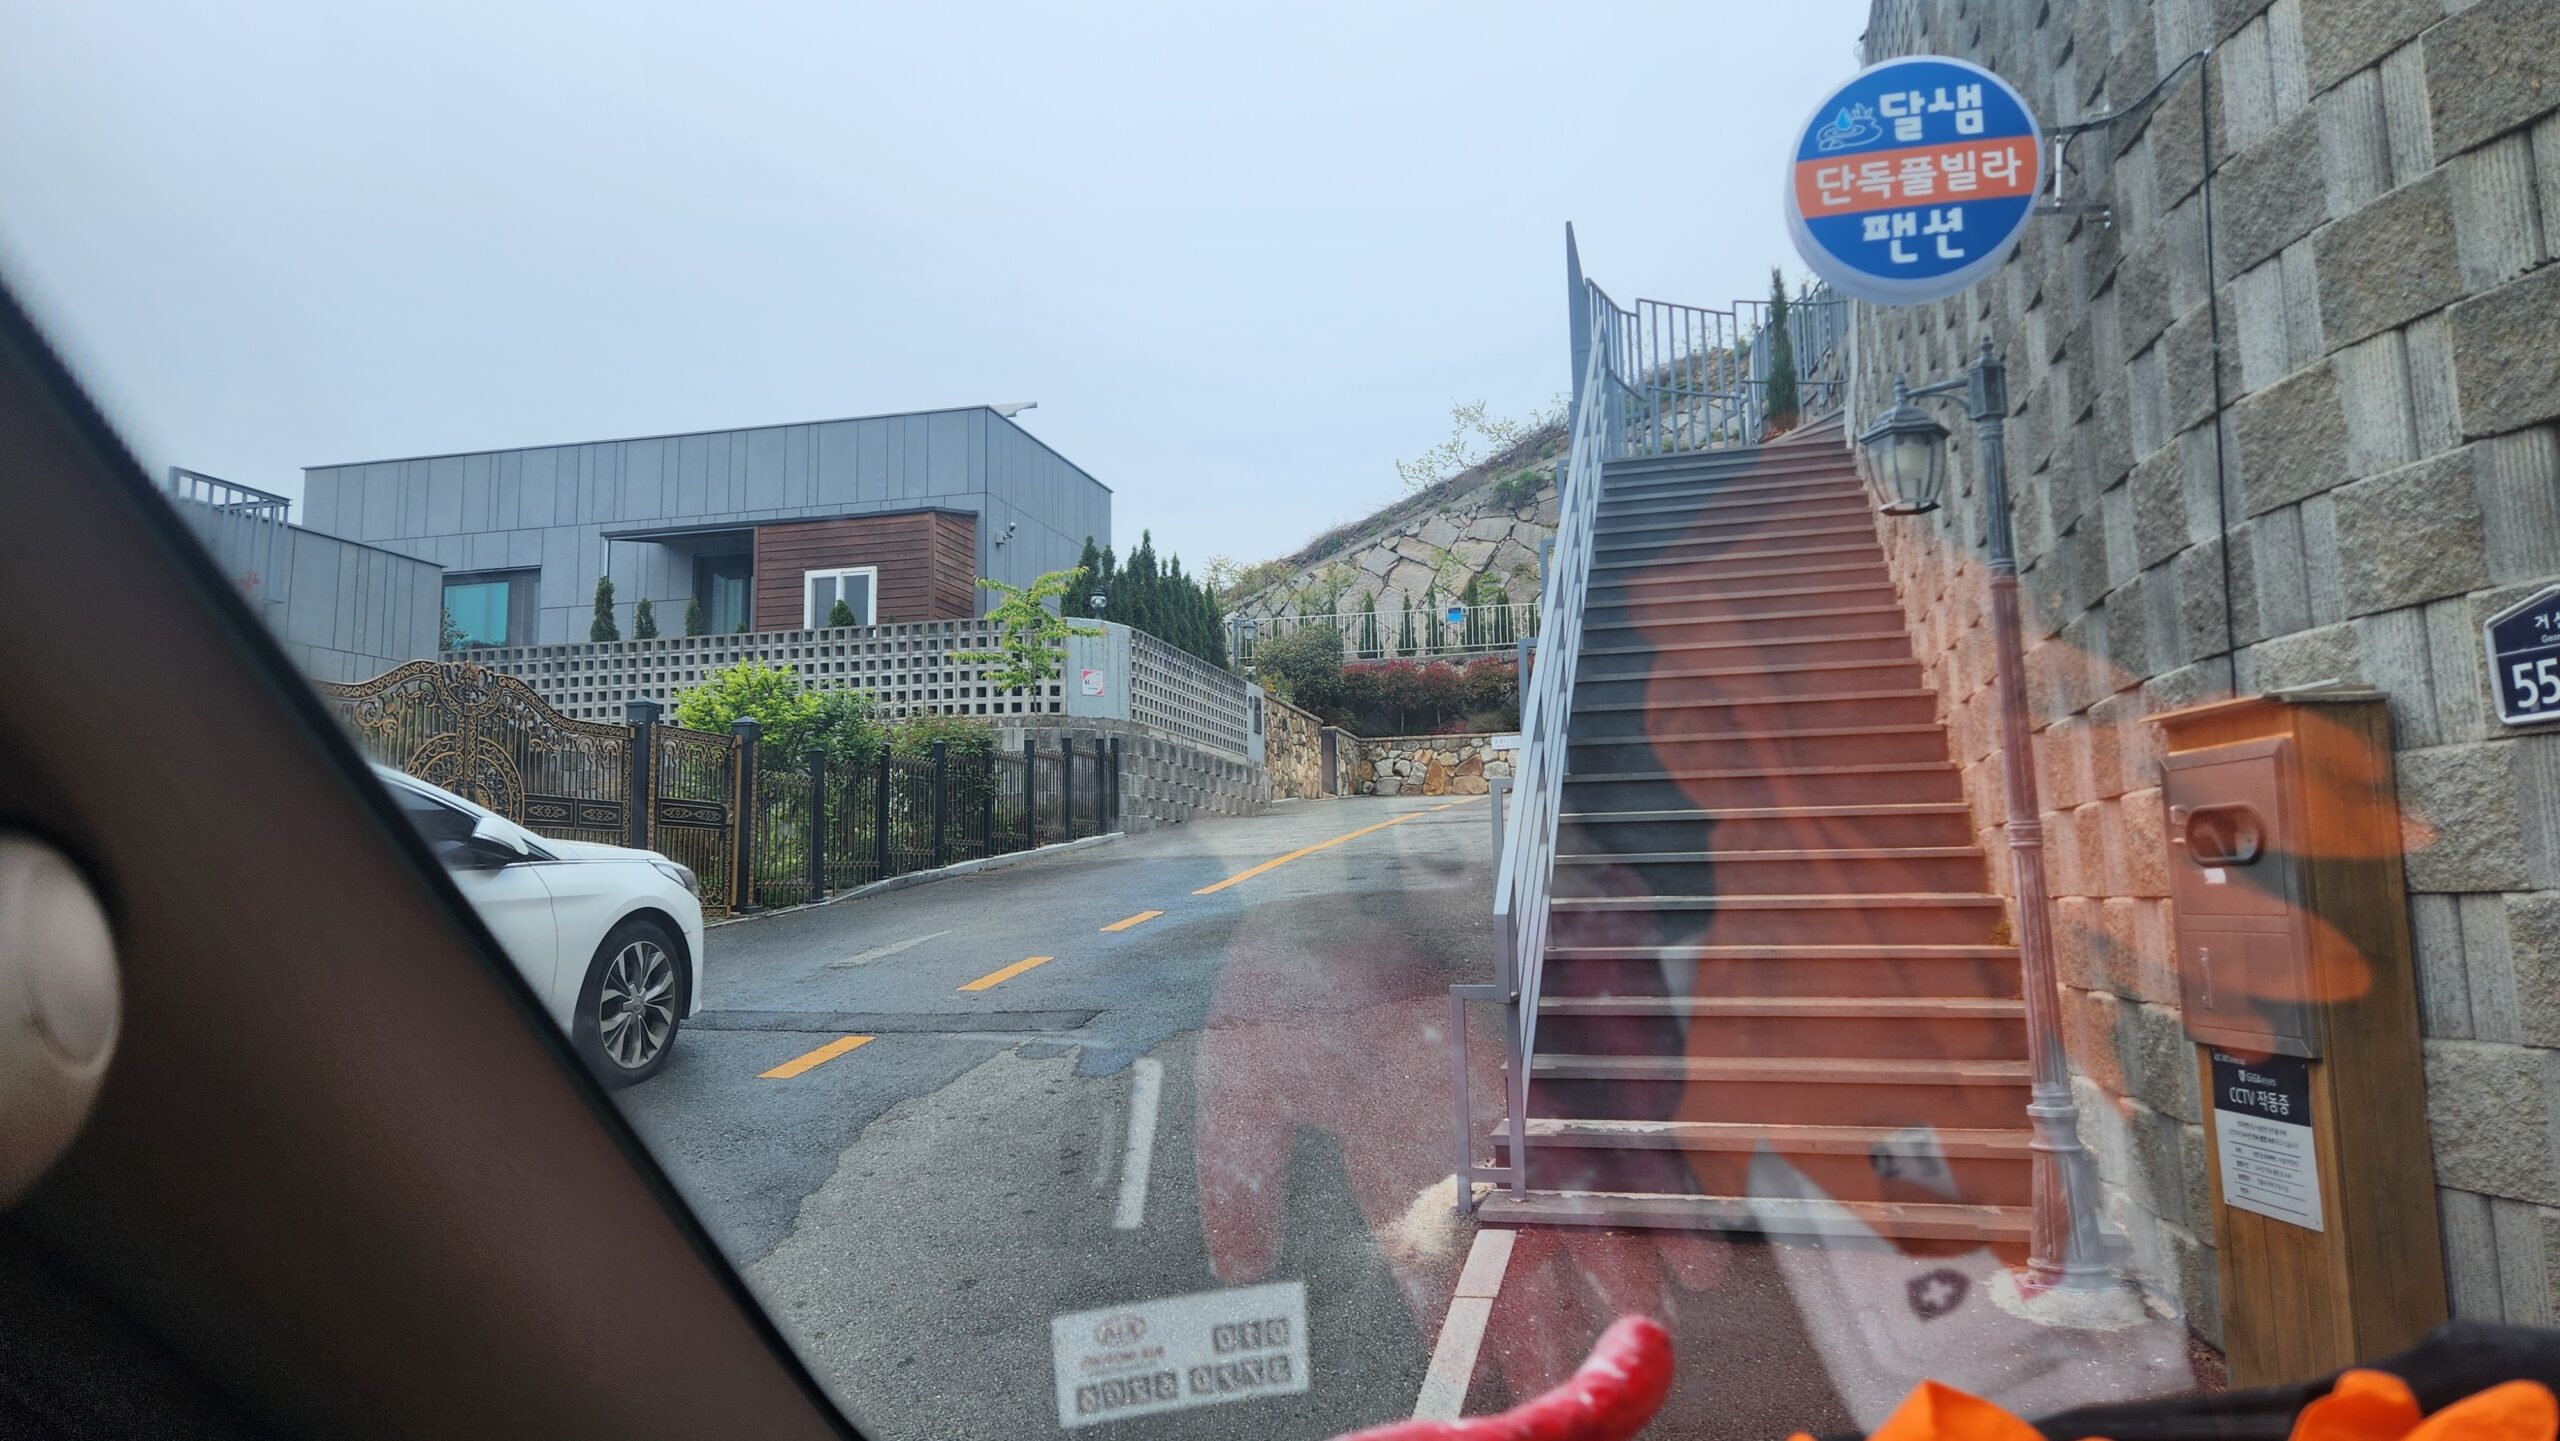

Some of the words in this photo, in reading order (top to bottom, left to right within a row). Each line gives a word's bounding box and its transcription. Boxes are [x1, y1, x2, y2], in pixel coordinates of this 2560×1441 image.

[1879, 83, 1984, 142] 달샘
[1816, 146, 2022, 206] 단독풀빌라
[1862, 207, 1965, 264] 팬션
[2229, 1086, 2254, 1106] CCTV
[2257, 1090, 2290, 1116] 작동중
